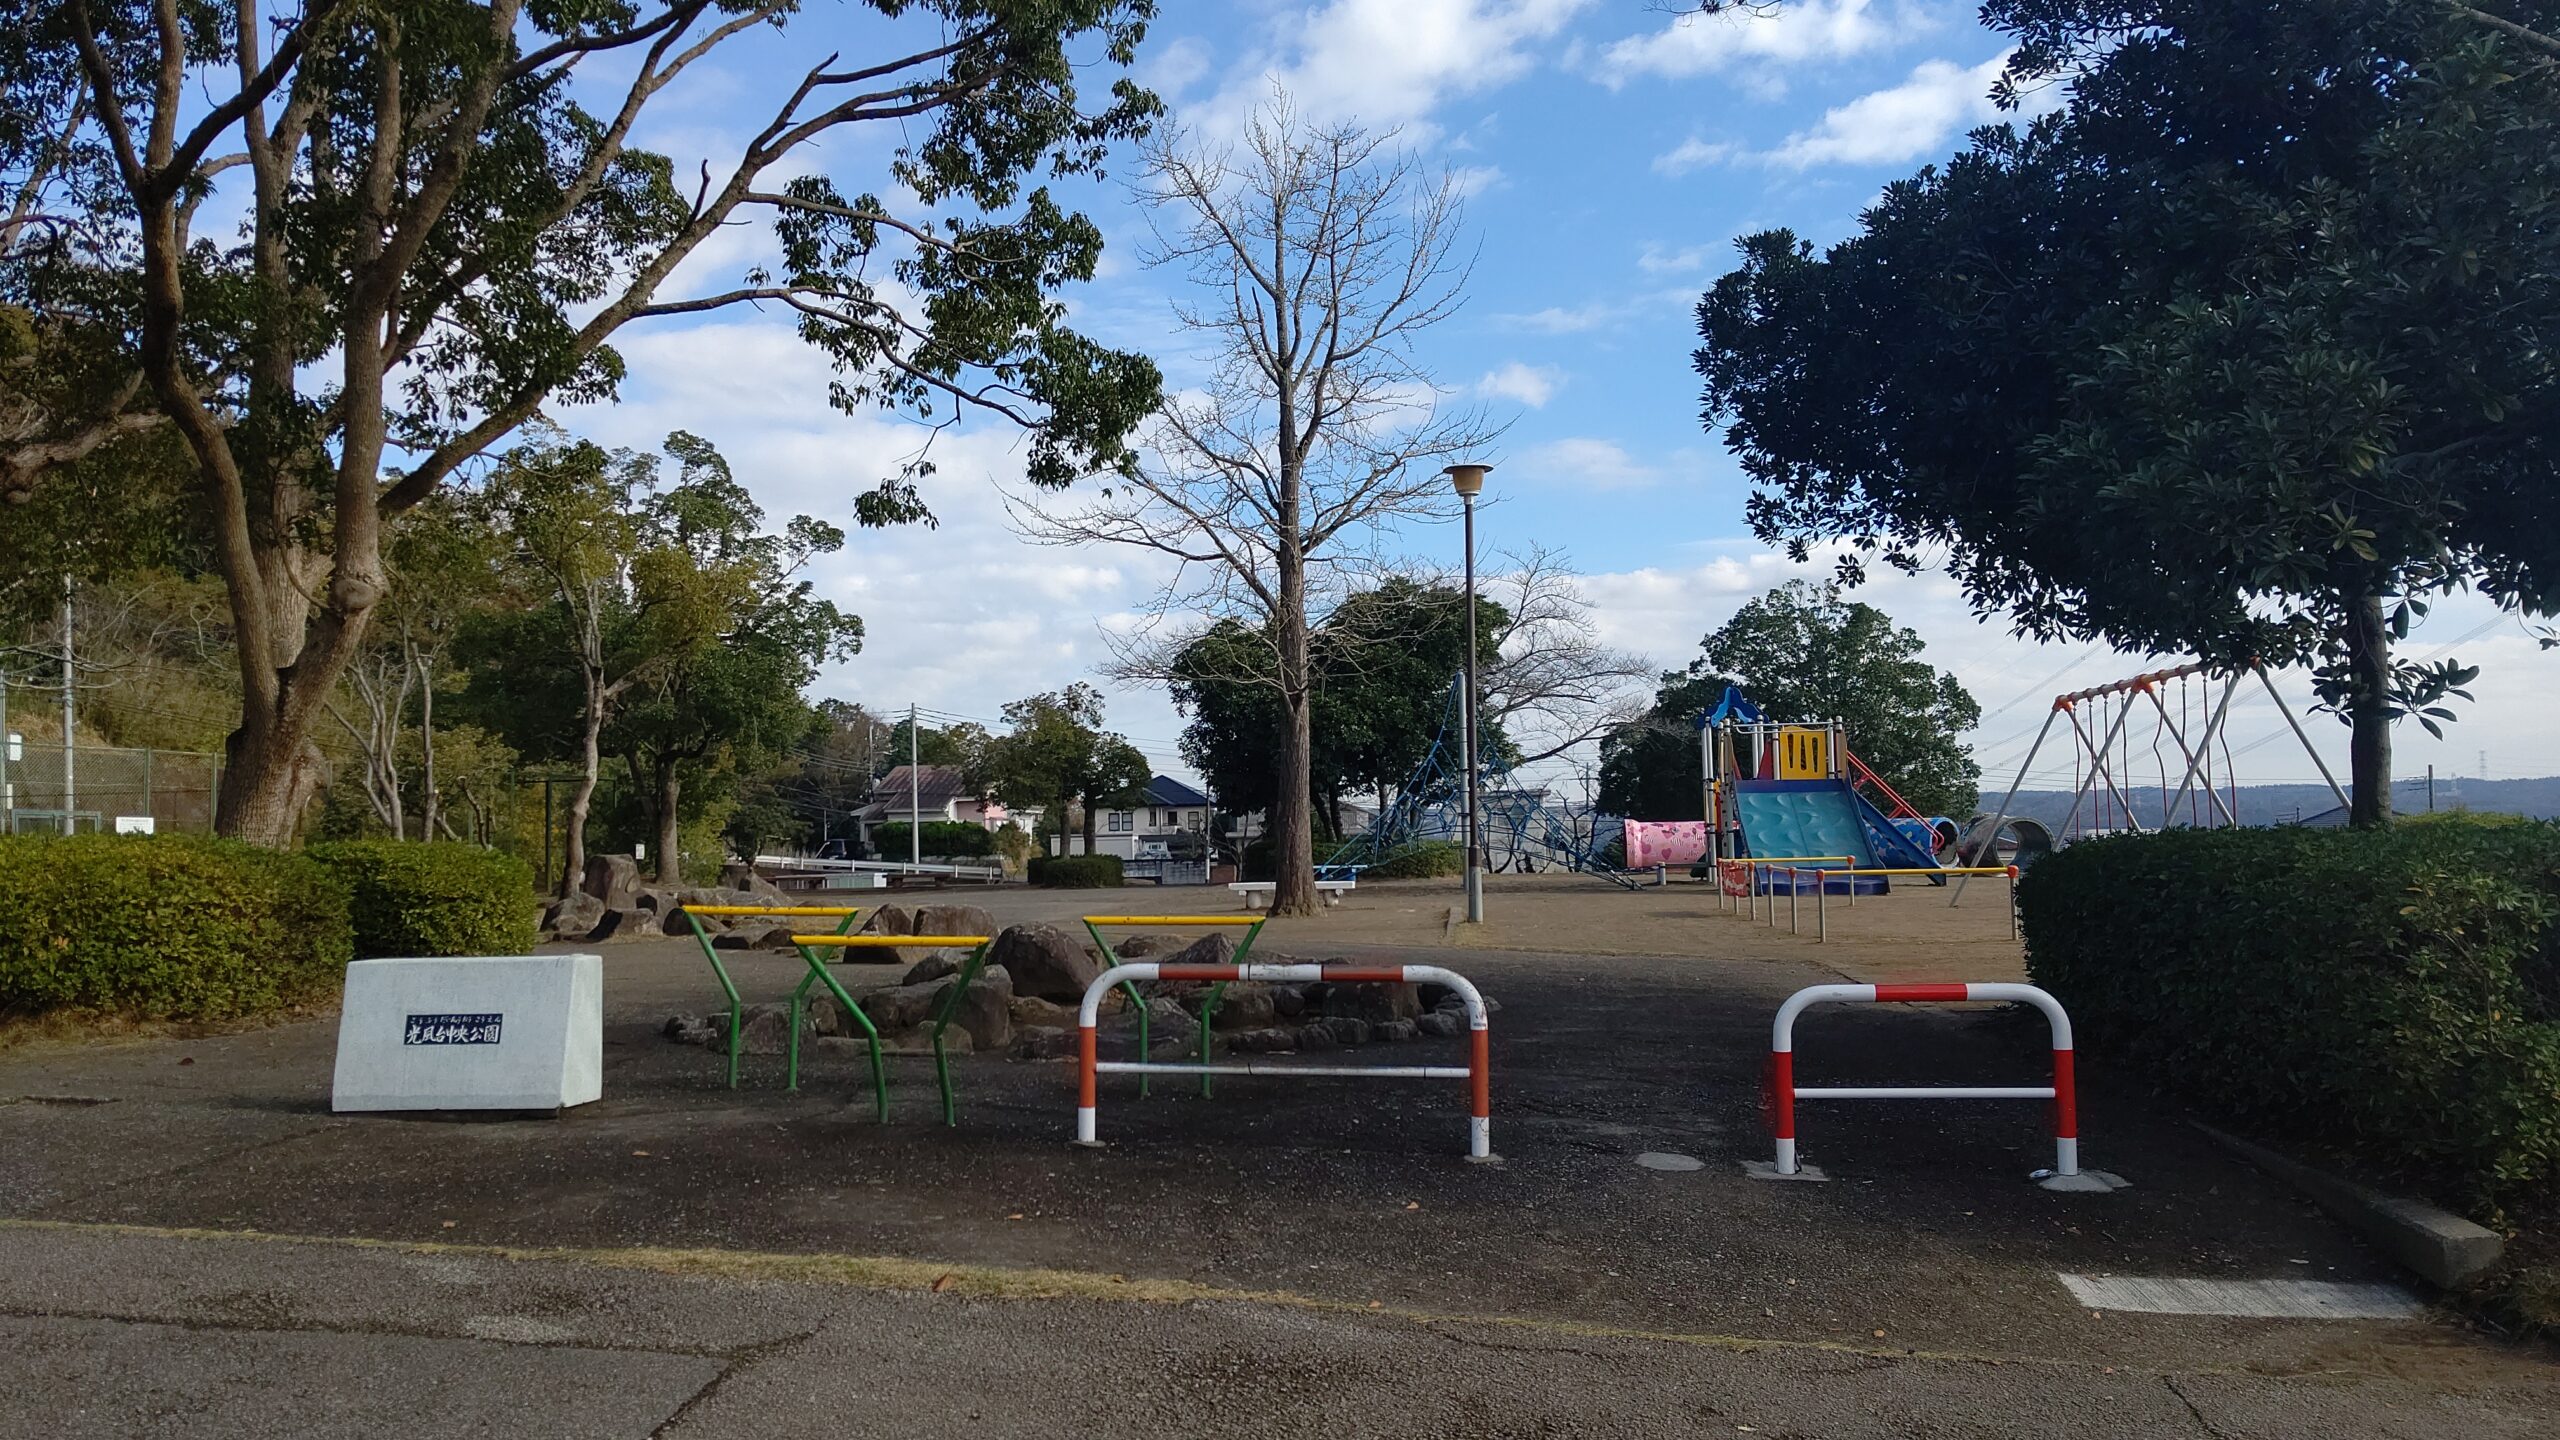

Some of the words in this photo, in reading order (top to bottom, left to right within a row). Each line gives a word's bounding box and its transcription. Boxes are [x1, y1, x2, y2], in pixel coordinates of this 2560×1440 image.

[406, 1024, 500, 1044] 光風台中央公園
